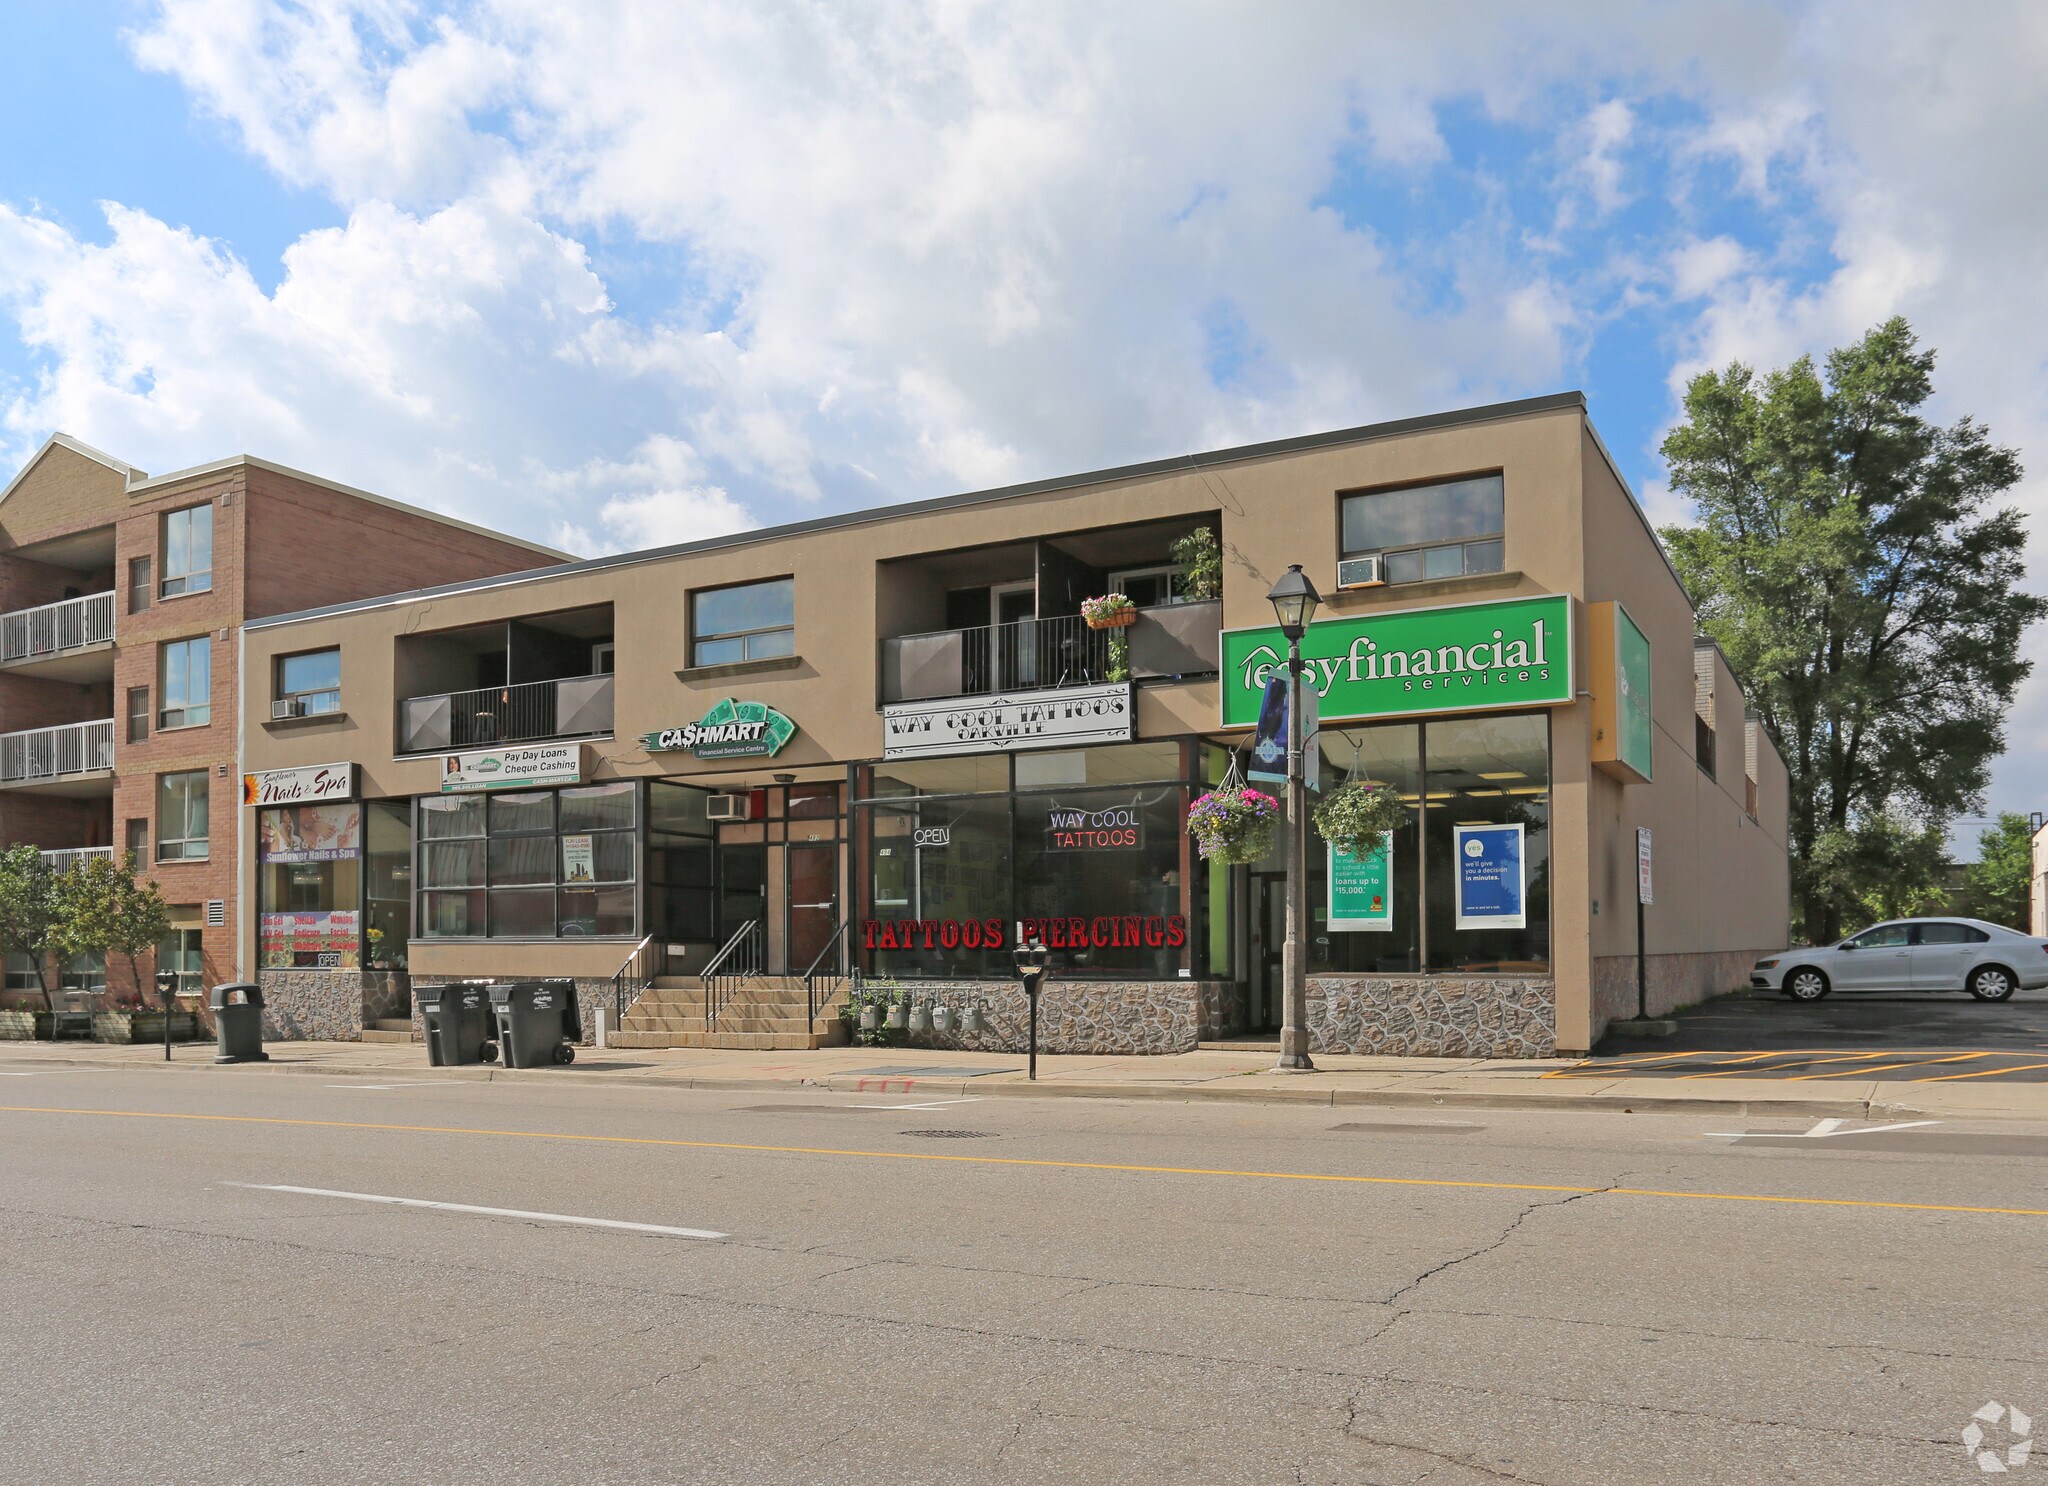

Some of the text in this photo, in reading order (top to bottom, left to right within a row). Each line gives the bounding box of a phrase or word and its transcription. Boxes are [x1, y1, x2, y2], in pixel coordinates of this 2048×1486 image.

[1251, 618, 1549, 698] esyfinancial
[1403, 669, 1551, 692] services
[890, 696, 1125, 734] WAY COOL TATTOOS
[957, 721, 1048, 740] OAKVILLE
[504, 749, 567, 762] Pay Day Loans
[699, 745, 765, 756] Financial Service Centre
[504, 760, 576, 774] Cheque Cashing
[263, 771, 297, 784] Sunflower
[260, 781, 302, 803] Nails
[314, 769, 347, 797] Spa
[1050, 810, 1140, 828] WAY COOL
[914, 828, 950, 843] OPEN
[1054, 829, 1136, 848] TATTOOS
[266, 848, 355, 862] Sunflower Nails & Spa
[330, 915, 353, 924] Waxing
[330, 928, 349, 937] Facial
[862, 918, 1003, 949] TATTOOS
[1020, 915, 1187, 949] PIERCINGS
[319, 954, 340, 967] OPEN
